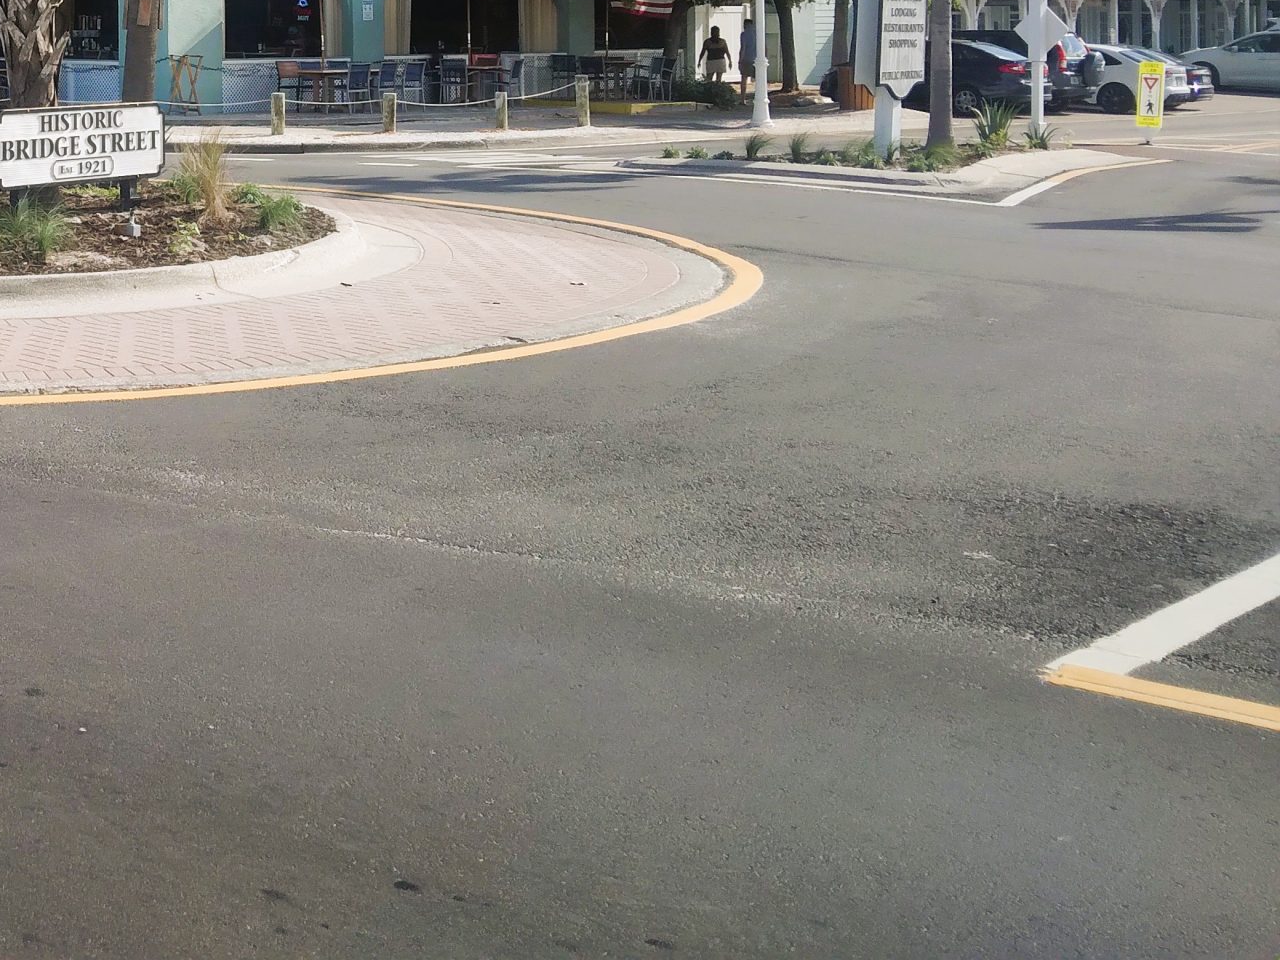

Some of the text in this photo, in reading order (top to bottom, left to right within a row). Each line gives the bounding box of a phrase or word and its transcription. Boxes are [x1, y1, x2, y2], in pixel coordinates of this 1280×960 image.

[891, 8, 917, 17] LODGING
[884, 24, 924, 32] RESTAURANTS
[889, 39, 917, 48] SHOPPING
[881, 70, 923, 81] PUBLIC PARKING
[40, 110, 123, 132] HISTORIC
[0, 130, 160, 162] BRIDGE STREET
[77, 159, 107, 175] 1921
